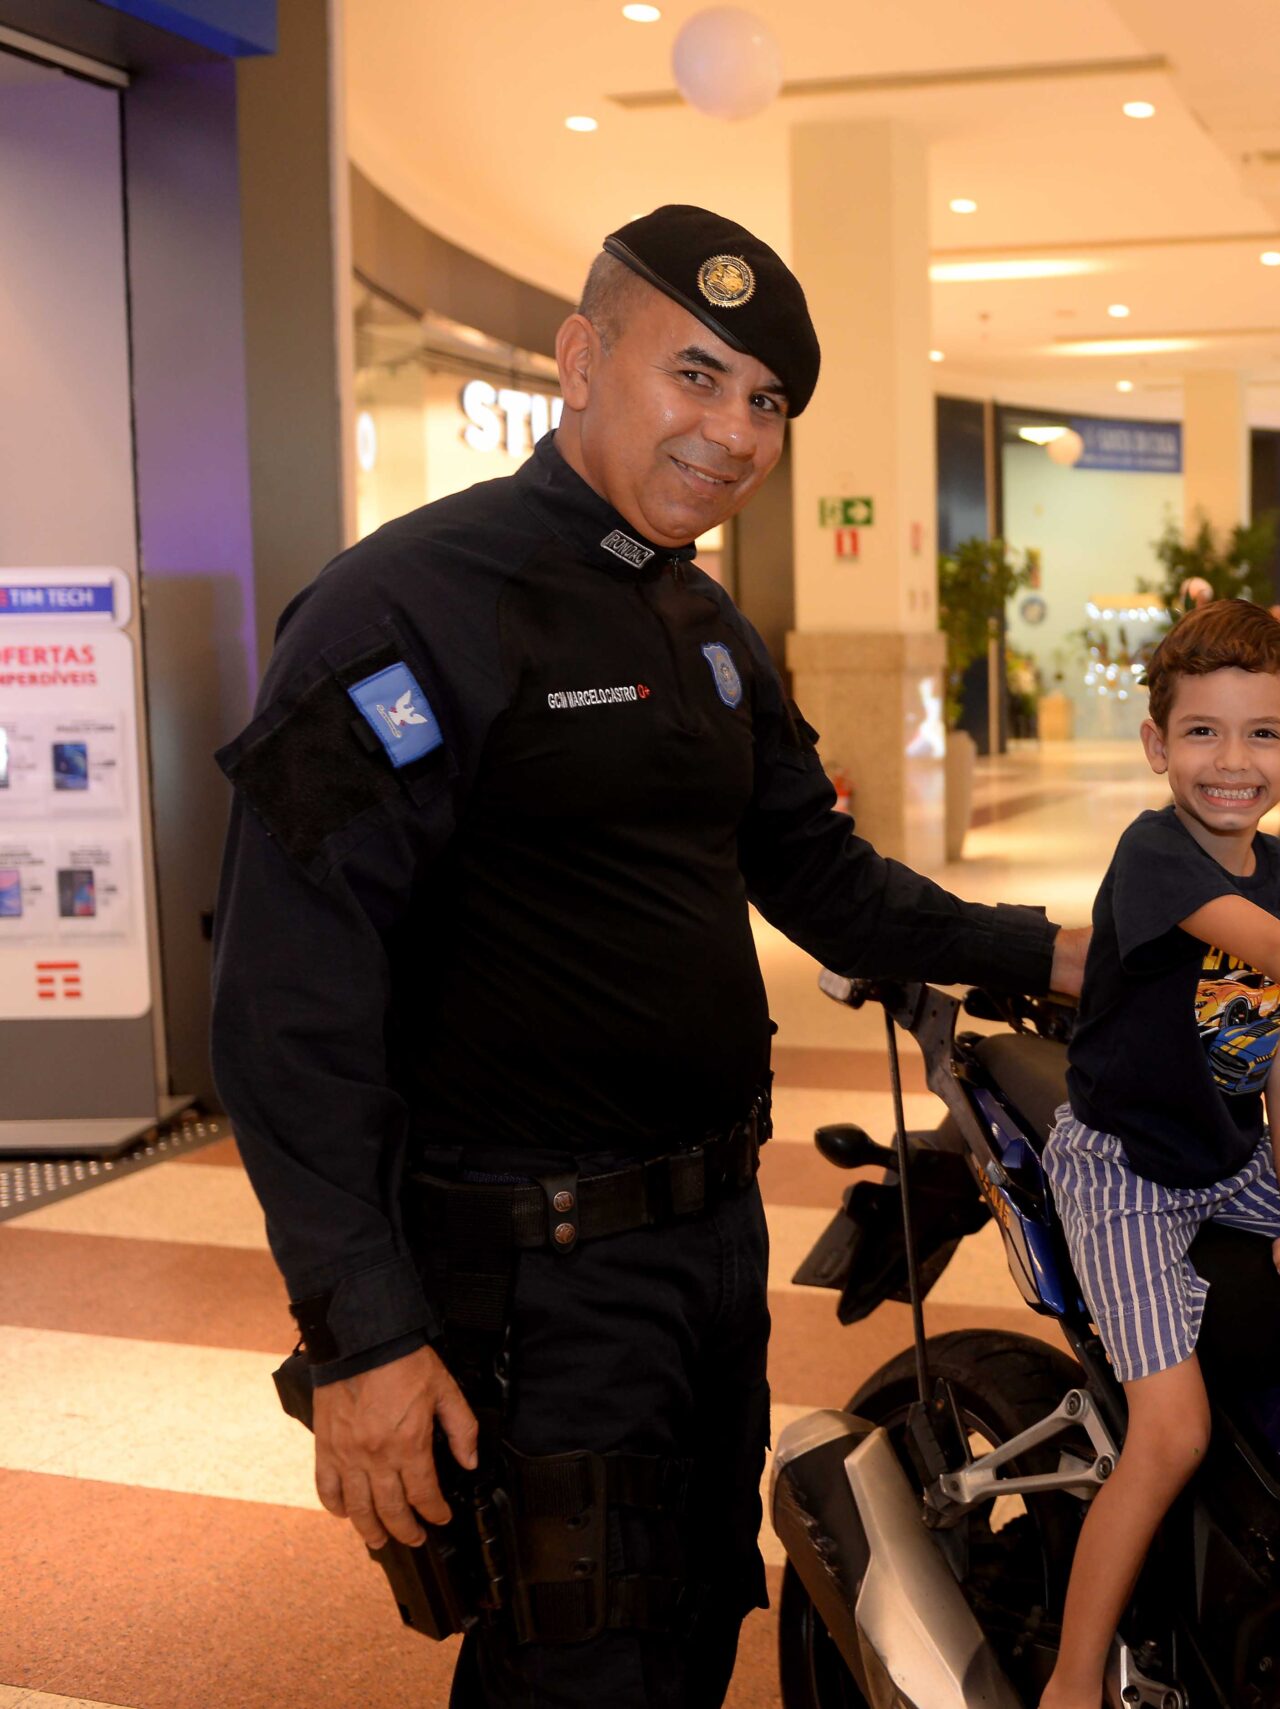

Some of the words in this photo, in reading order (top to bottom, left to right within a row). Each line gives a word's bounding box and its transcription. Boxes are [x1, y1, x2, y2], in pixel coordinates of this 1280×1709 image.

[9, 587, 44, 607] TIM
[47, 587, 95, 607] TECH
[0, 645, 95, 666] FERTAS
[566, 688, 607, 708] MARCELO
[605, 685, 637, 703] CASTRO
